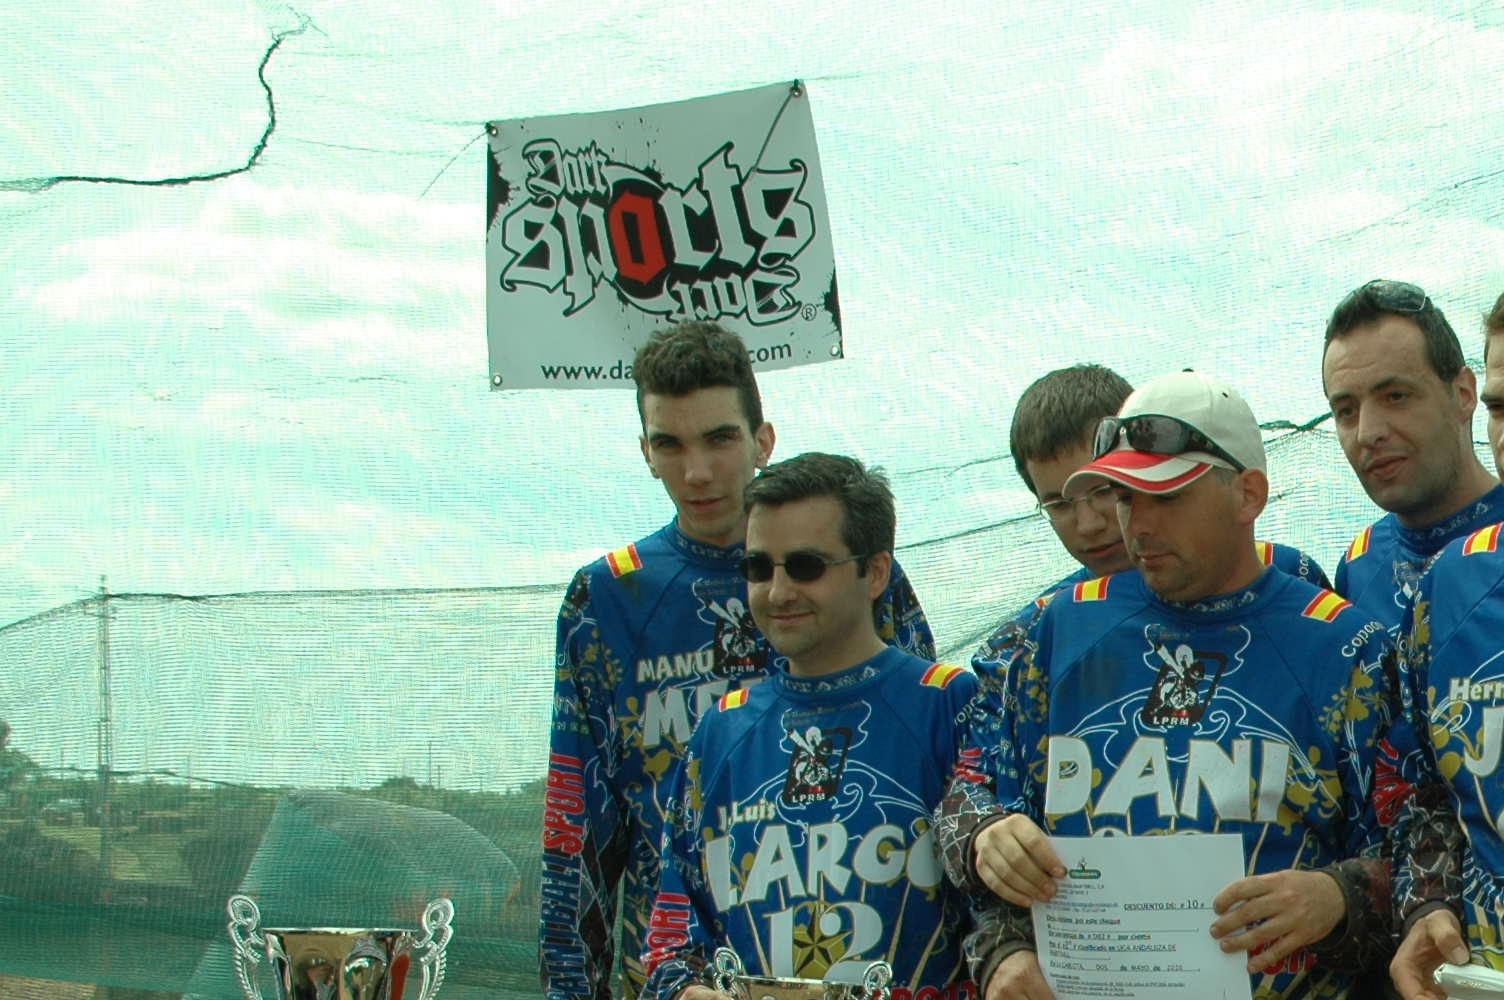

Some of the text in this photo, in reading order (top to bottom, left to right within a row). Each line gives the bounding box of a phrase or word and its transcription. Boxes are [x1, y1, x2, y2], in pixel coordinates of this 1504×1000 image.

[637, 650, 716, 683] MANU
[1152, 715, 1190, 727] LPRM
[543, 750, 586, 854] SPORT
[1045, 734, 1291, 824] DANI
